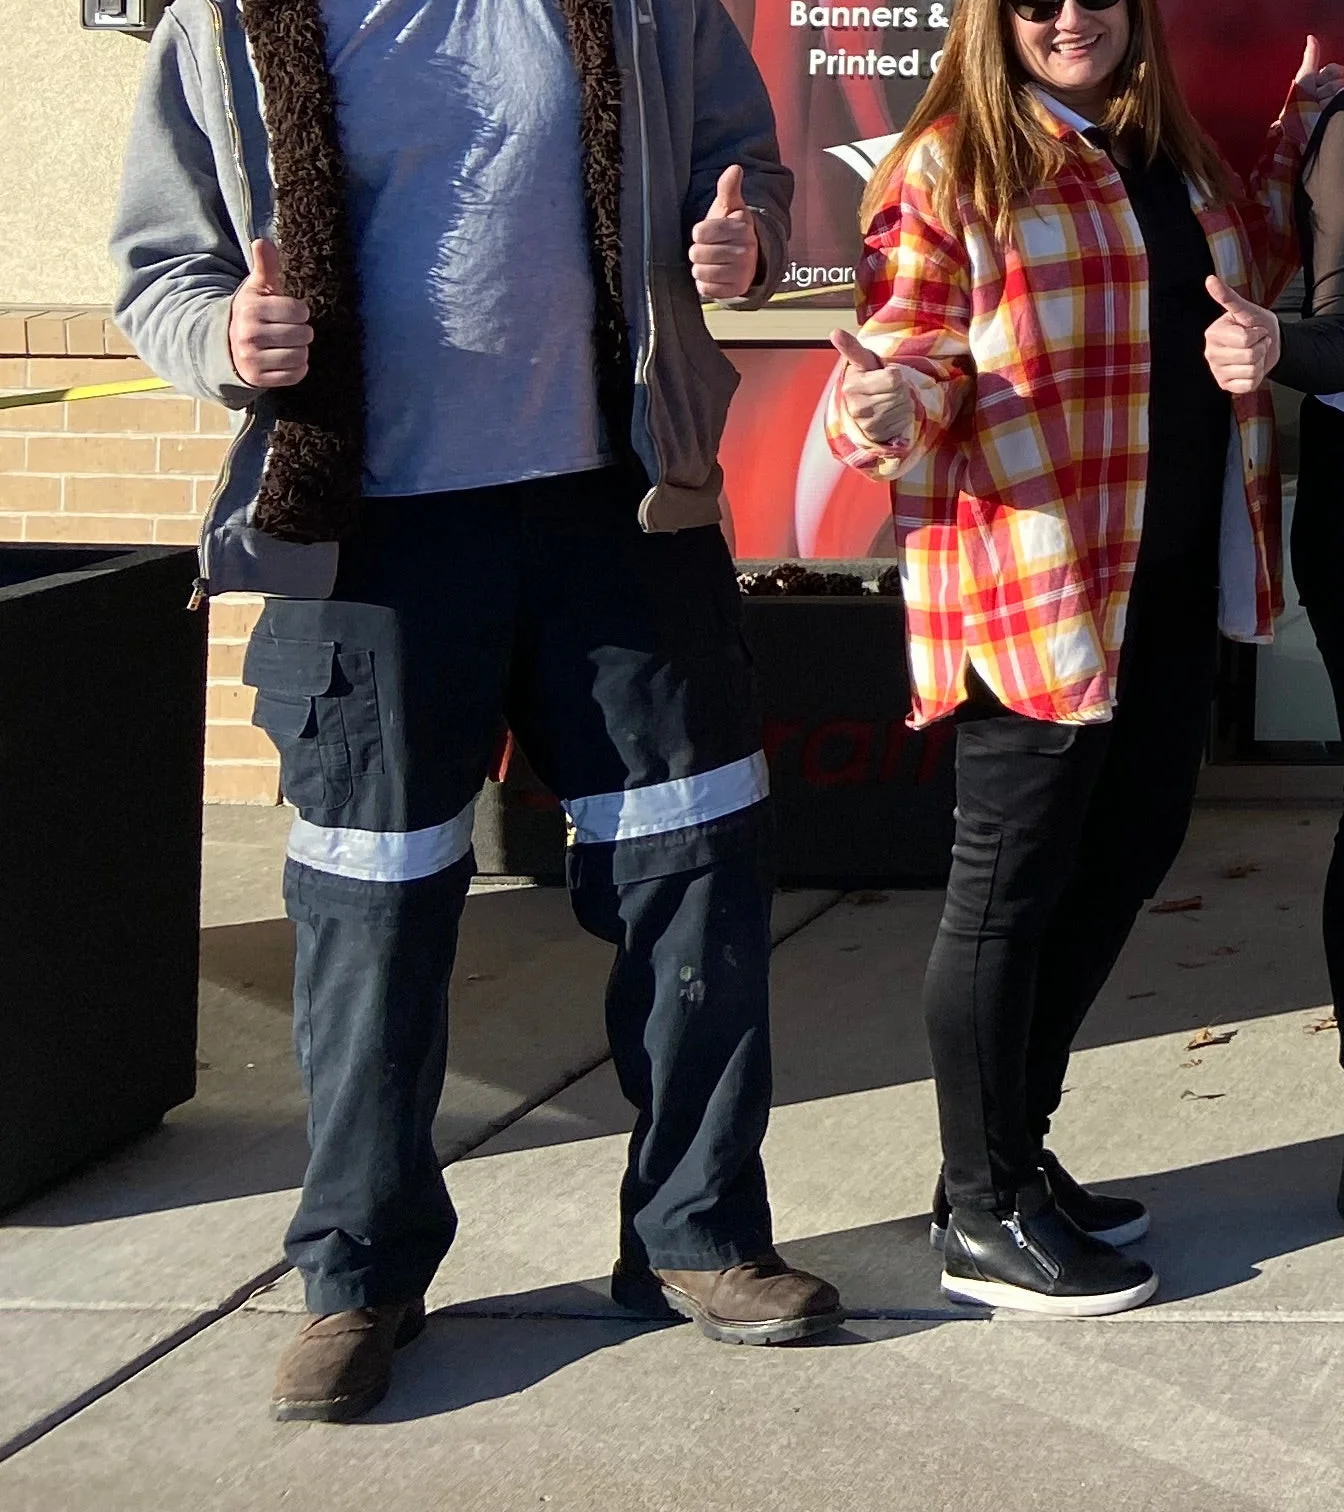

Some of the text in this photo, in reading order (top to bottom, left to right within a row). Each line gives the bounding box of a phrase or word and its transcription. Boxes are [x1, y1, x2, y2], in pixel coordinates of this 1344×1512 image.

[790, 0, 950, 28] Banners &
[809, 48, 919, 76] Printed
[781, 261, 856, 287] ignar
